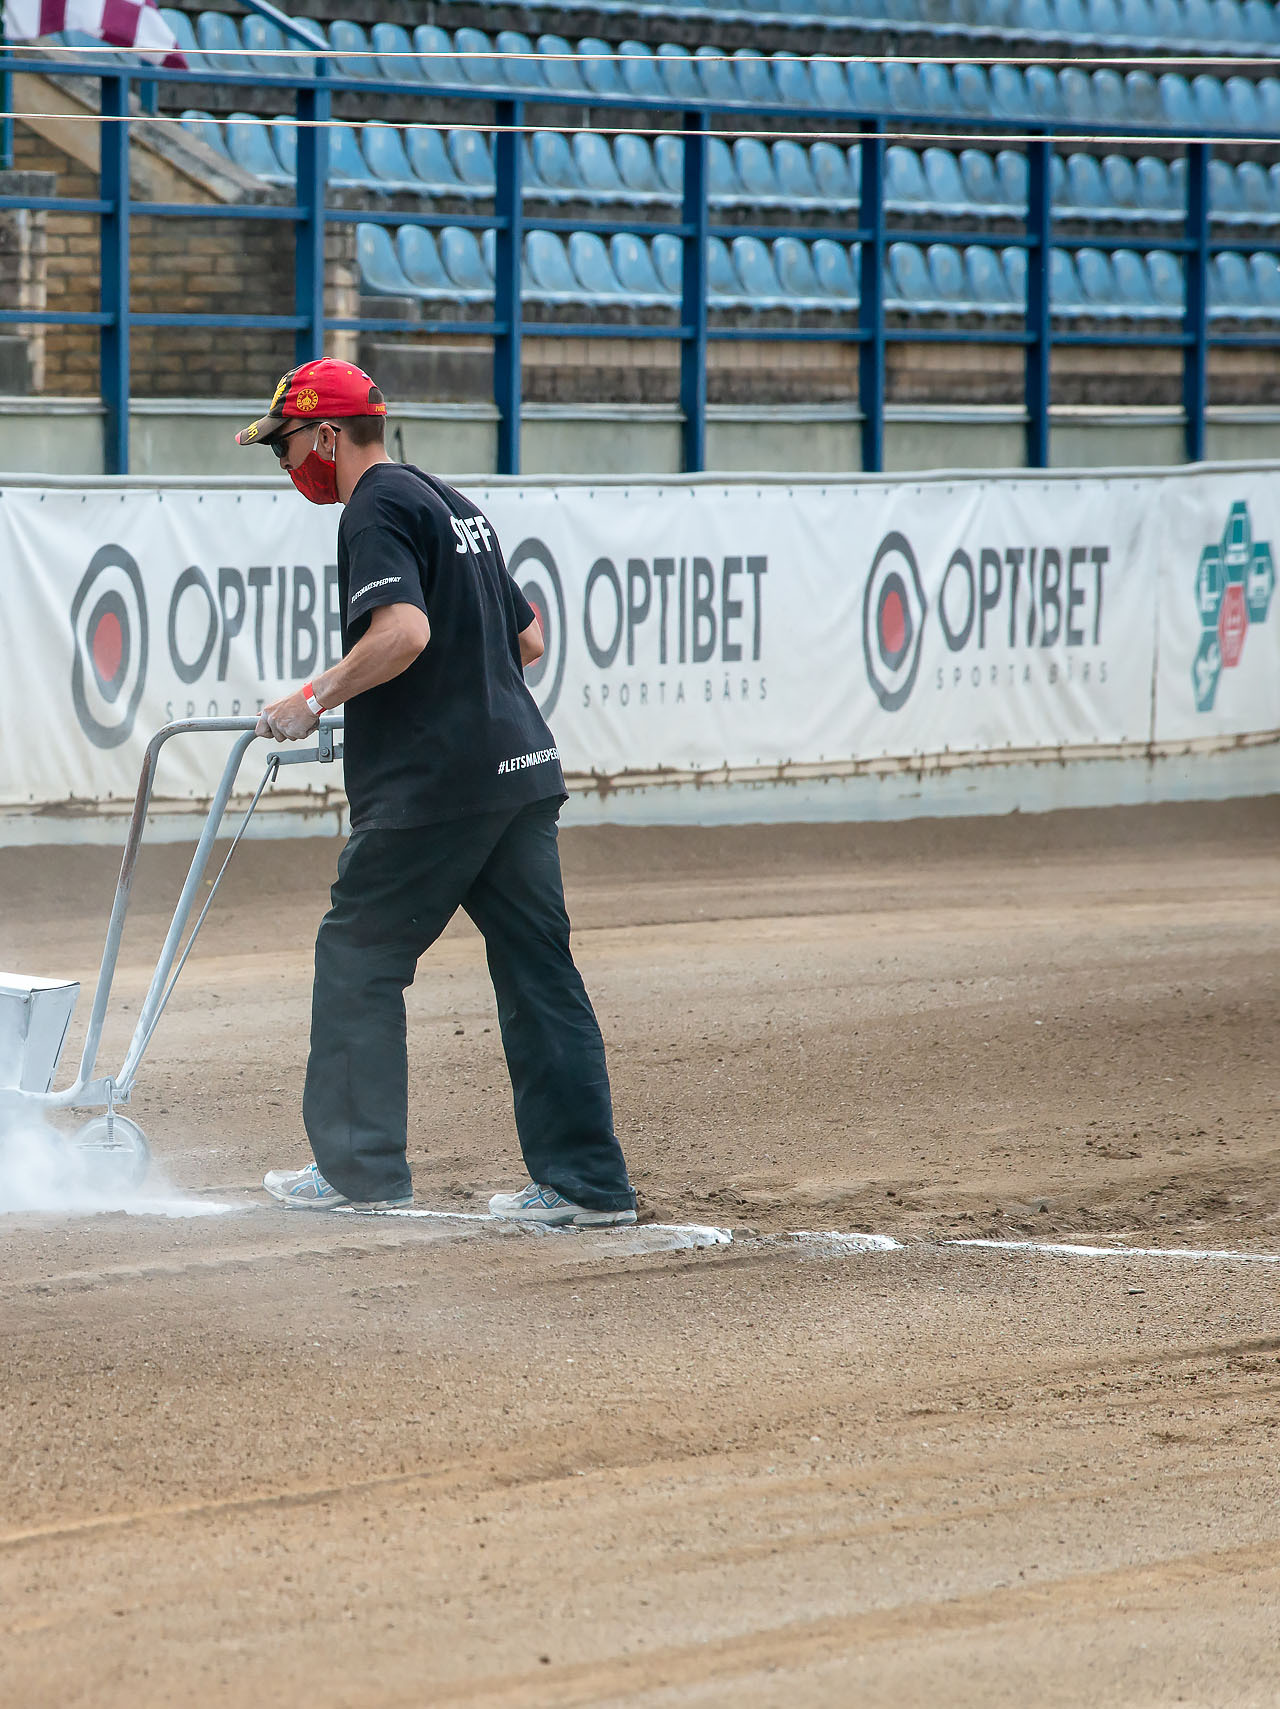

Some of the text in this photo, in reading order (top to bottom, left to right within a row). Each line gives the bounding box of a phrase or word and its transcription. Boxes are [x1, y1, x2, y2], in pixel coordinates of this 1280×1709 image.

[168, 565, 342, 684] OPTIBE
[584, 556, 768, 669] OPTIBET
[938, 546, 1110, 652] OPTIBET
[583, 681, 685, 708] SPORTA
